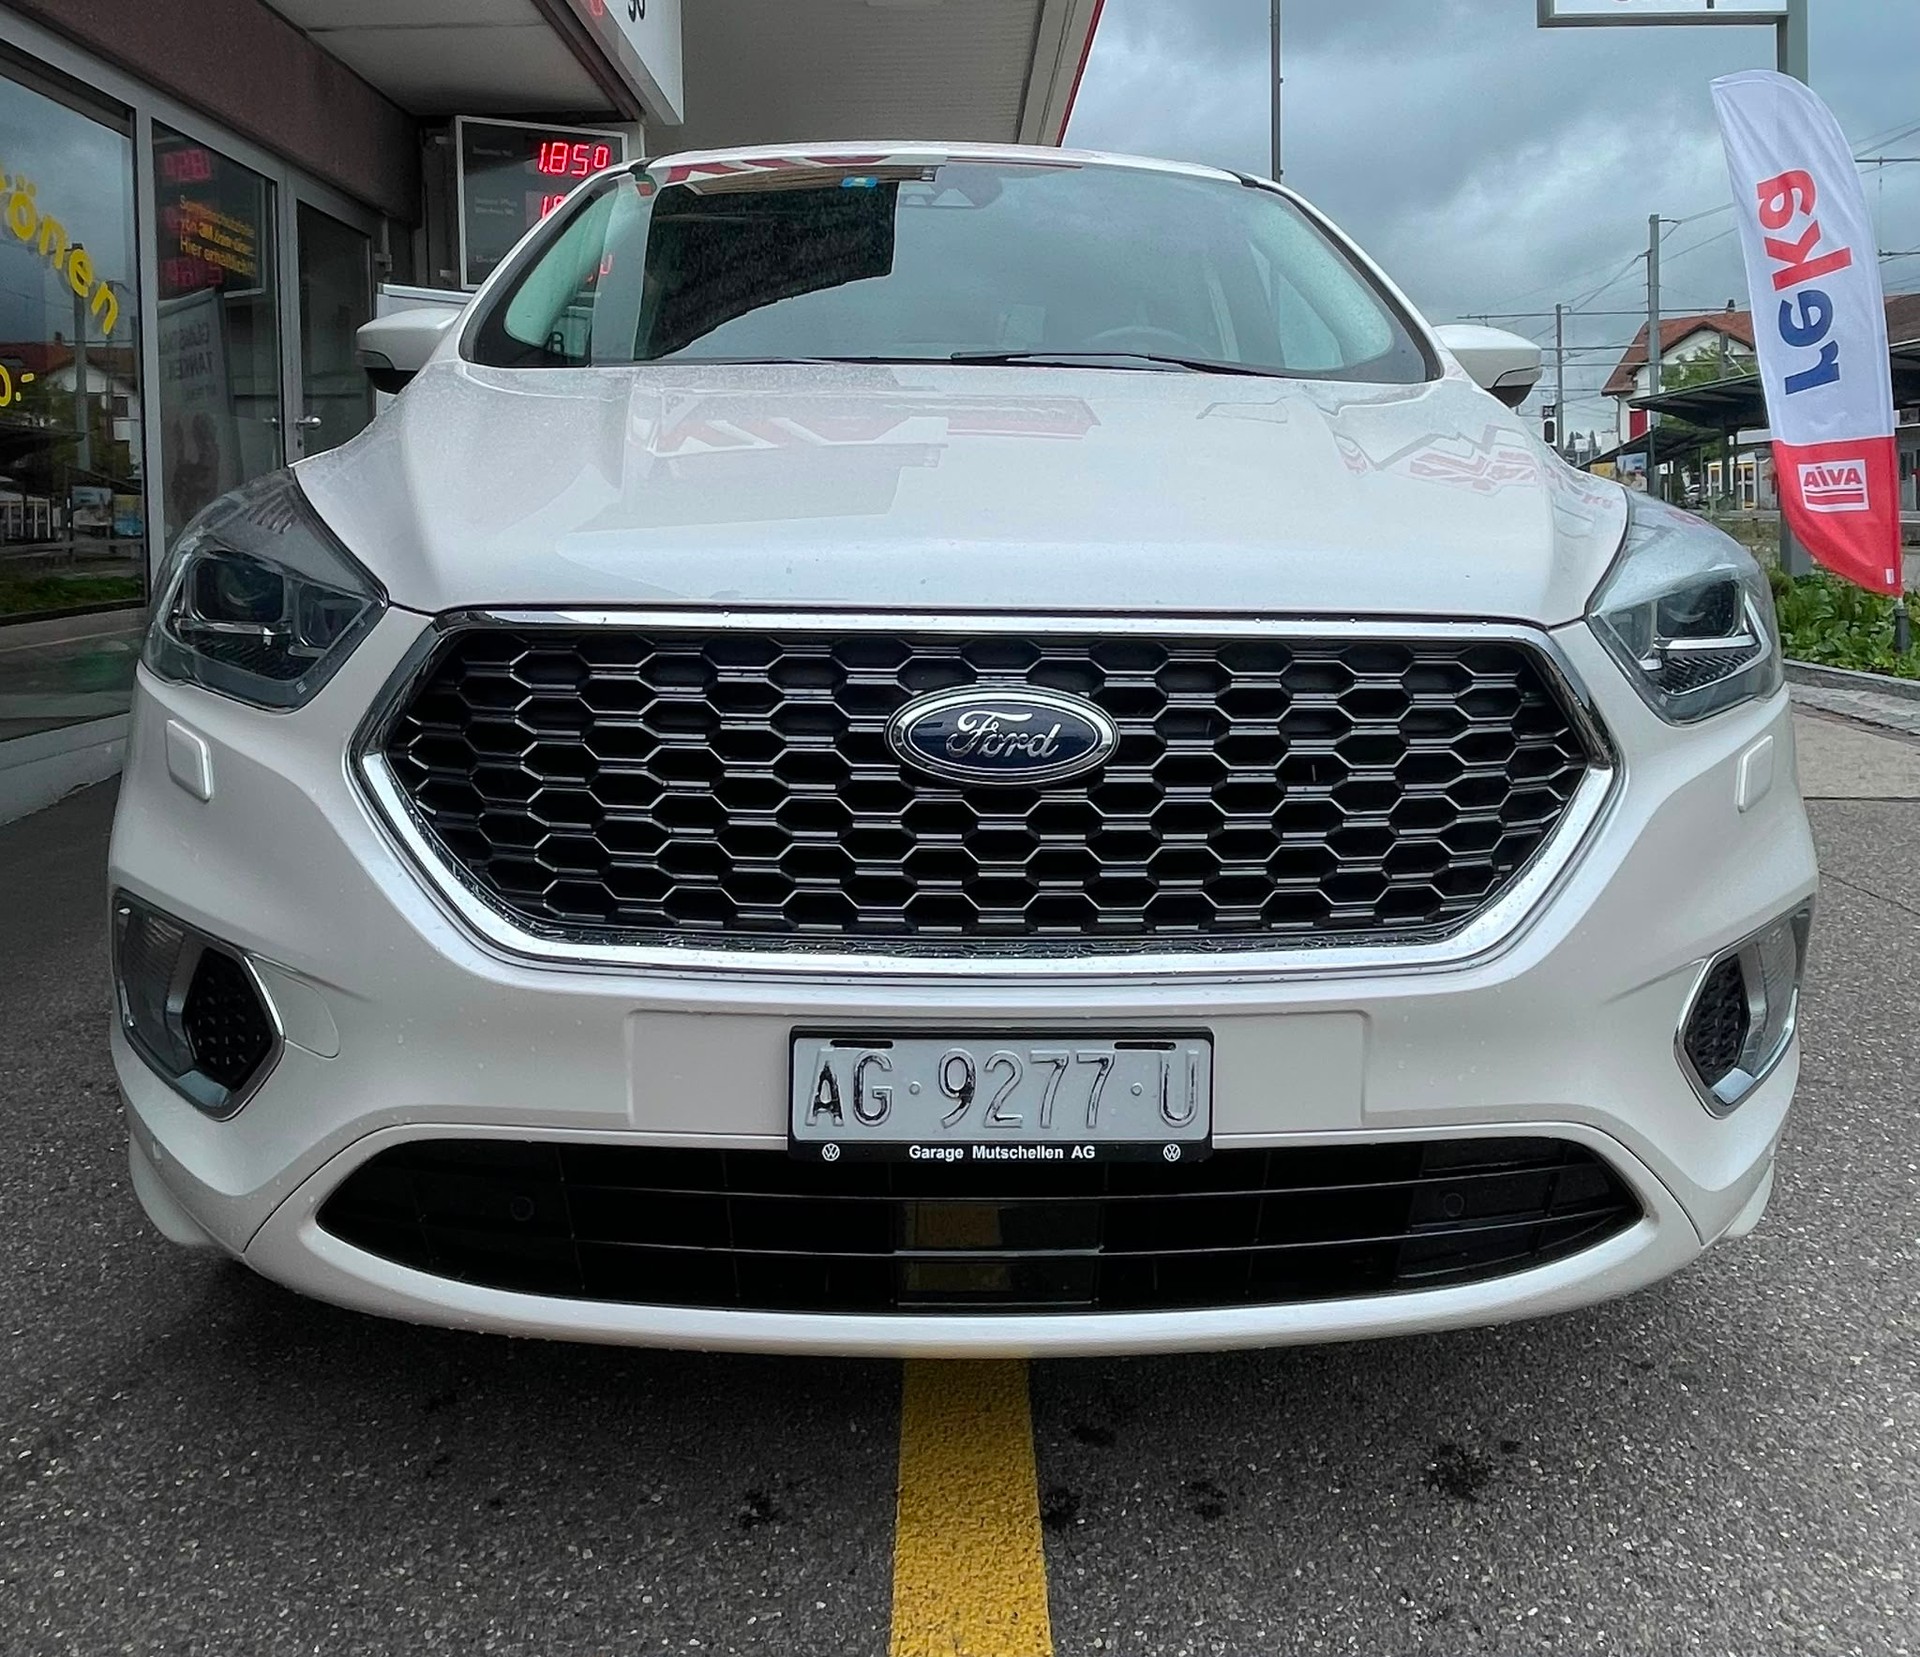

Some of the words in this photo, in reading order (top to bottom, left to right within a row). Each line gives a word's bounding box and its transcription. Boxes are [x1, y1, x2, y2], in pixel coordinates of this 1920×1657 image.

[0, 164, 119, 335] önen
[945, 710, 1061, 758] Ford
[805, 1048, 893, 1127] AG
[938, 1048, 1116, 1128] 9277
[1159, 1049, 1199, 1128] U
[909, 1145, 963, 1161] Garage
[972, 1145, 1064, 1159] Mutschellen
[1071, 1145, 1095, 1159] AG
